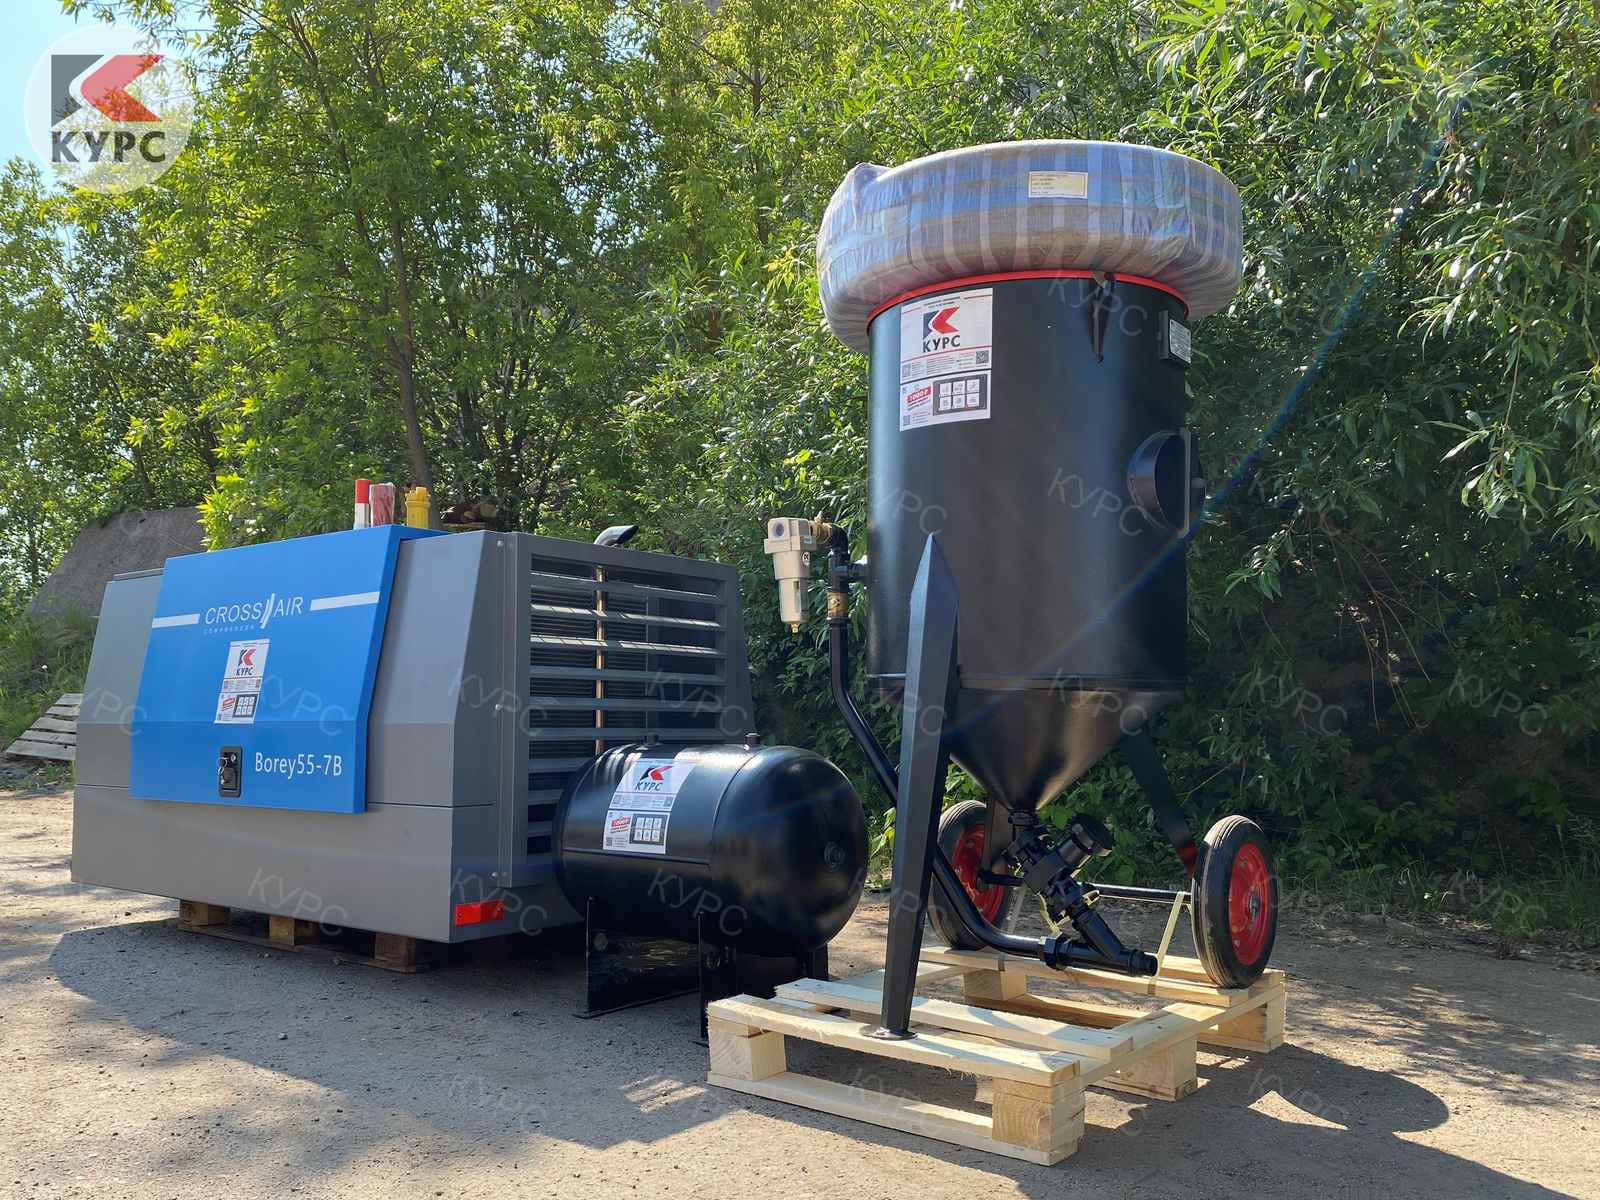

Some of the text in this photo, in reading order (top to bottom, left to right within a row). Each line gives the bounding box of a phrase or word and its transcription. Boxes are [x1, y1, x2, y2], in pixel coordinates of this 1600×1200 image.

[923, 335, 961, 353] КУРС
[255, 752, 343, 779] Borey55-7B
[635, 782, 664, 793] КУРС
